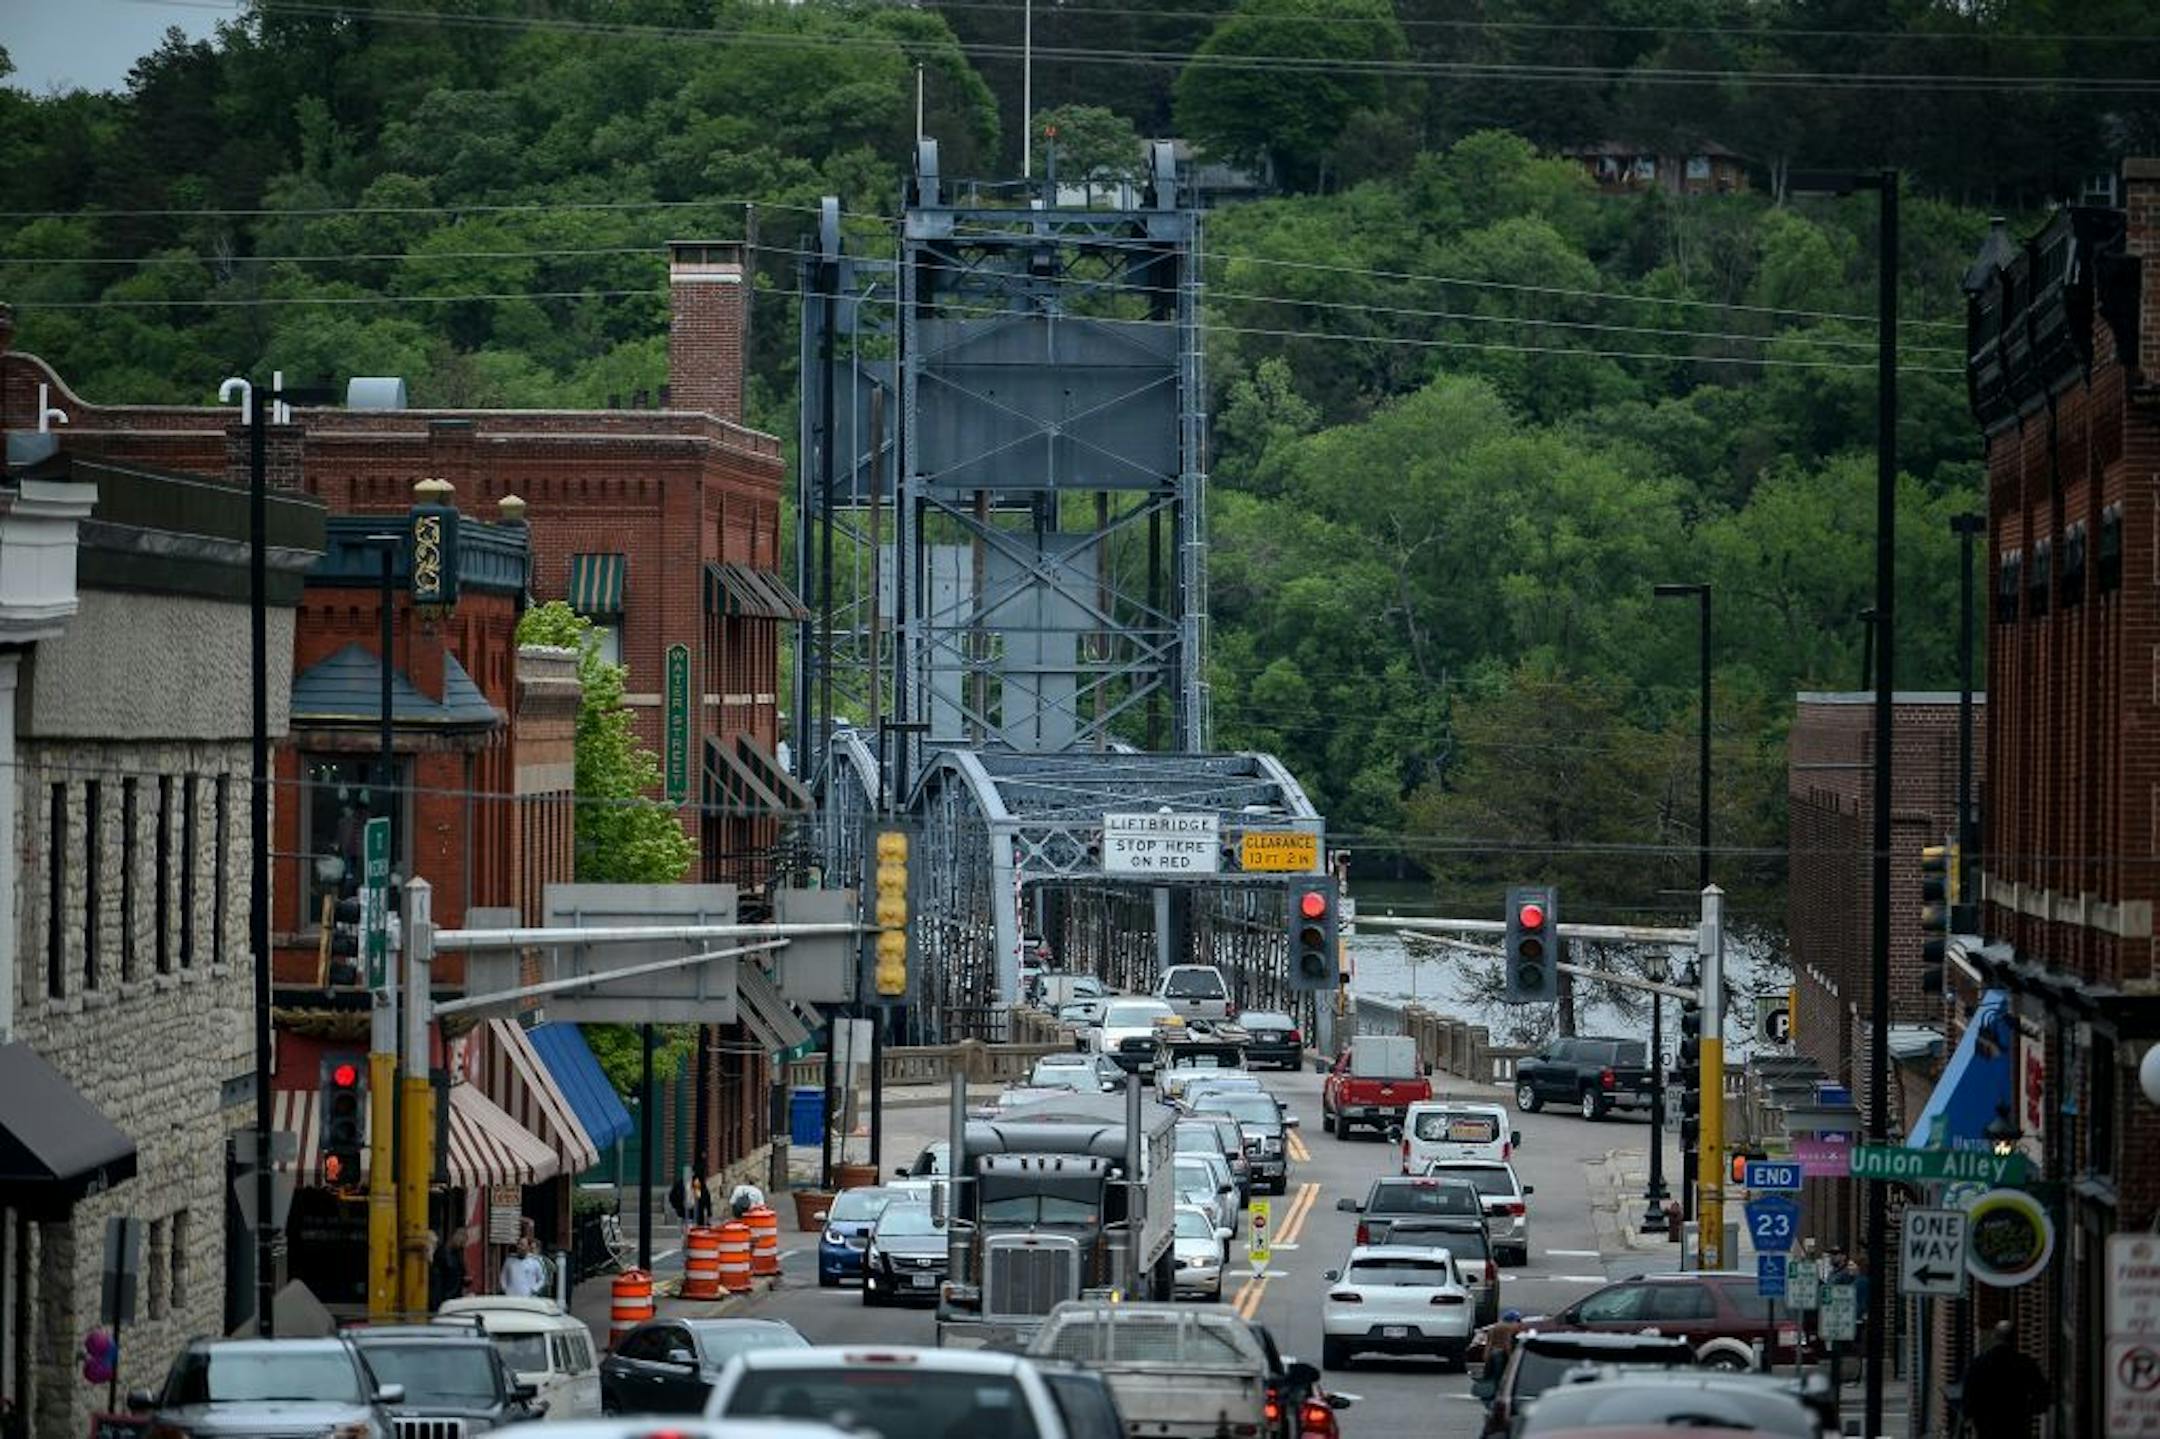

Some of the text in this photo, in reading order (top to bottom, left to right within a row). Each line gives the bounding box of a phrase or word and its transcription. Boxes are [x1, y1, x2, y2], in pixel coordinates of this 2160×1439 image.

[671, 651, 685, 786] WATER STREET
[1111, 818, 1209, 831] LIFTBRIDGE
[1117, 839, 1205, 853] STOP HERE
[1246, 837, 1314, 849] CLEARANCE
[1130, 856, 1191, 868] ON RED
[1250, 852, 1262, 864] 13
[1287, 852, 1296, 864] 2
[1850, 1147, 2008, 1183] Union Alley
[1754, 1167, 1793, 1186] END
[1756, 1213, 1790, 1237] 23
[1912, 1215, 1959, 1238] ONE
[1910, 1240, 1959, 1261] WAY
